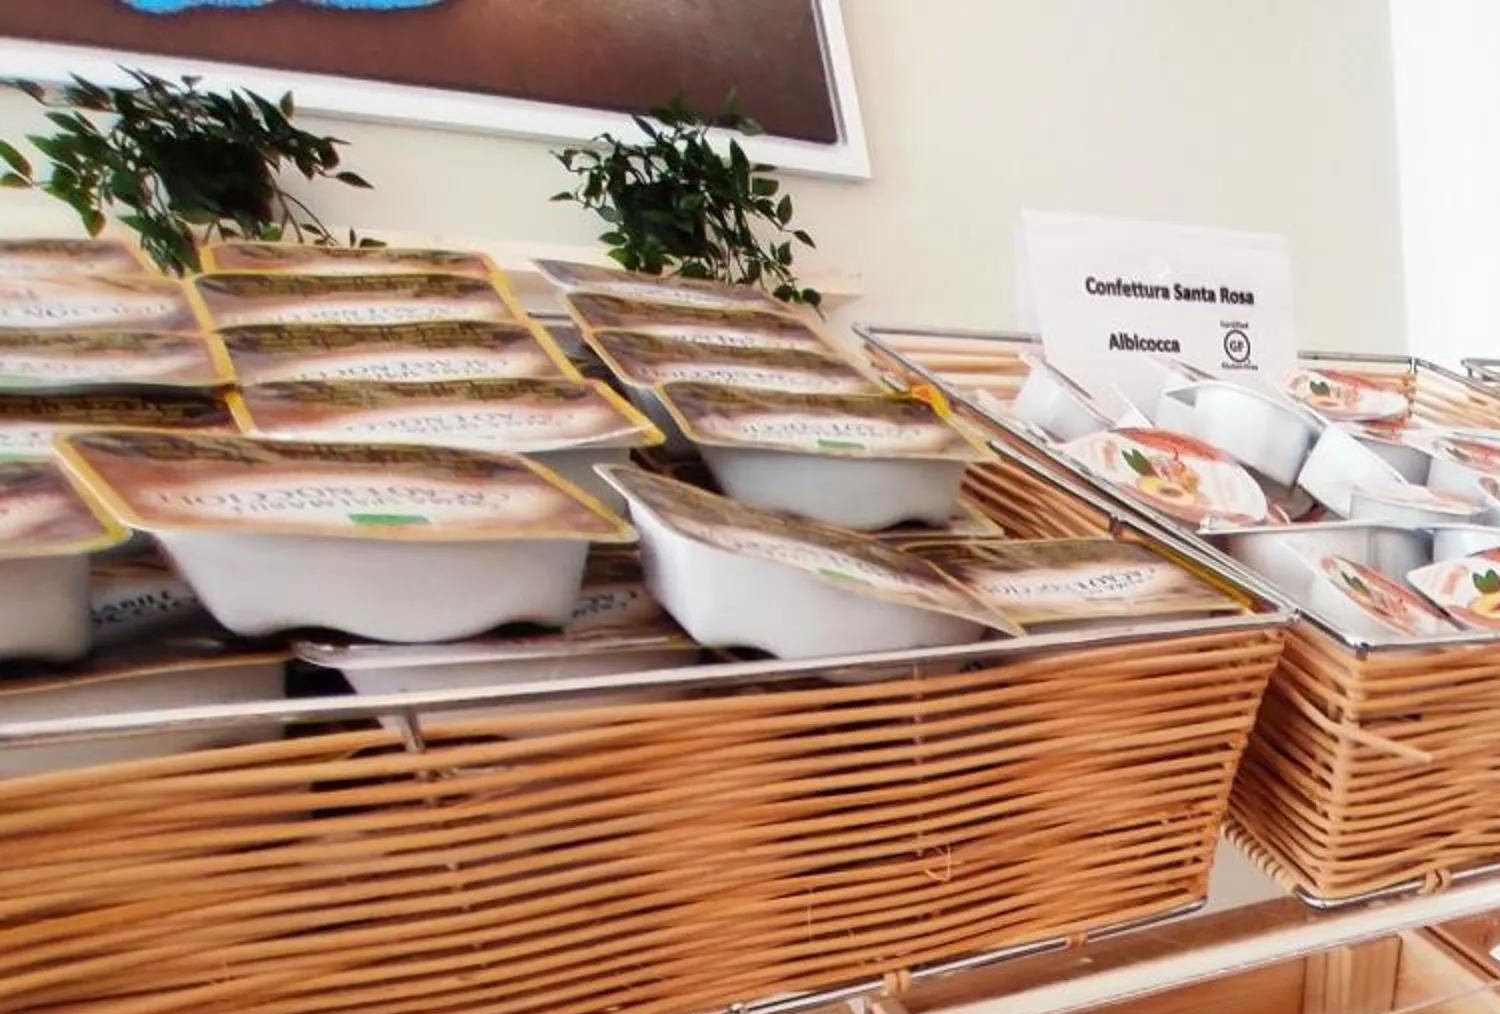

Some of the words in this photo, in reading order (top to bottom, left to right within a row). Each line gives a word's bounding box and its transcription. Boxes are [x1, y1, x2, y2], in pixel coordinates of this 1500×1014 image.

[1085, 276, 1170, 300] Confettura
[1173, 282, 1216, 303] Santa
[1219, 286, 1254, 305] Rosa
[1108, 331, 1181, 353] Albicocca
